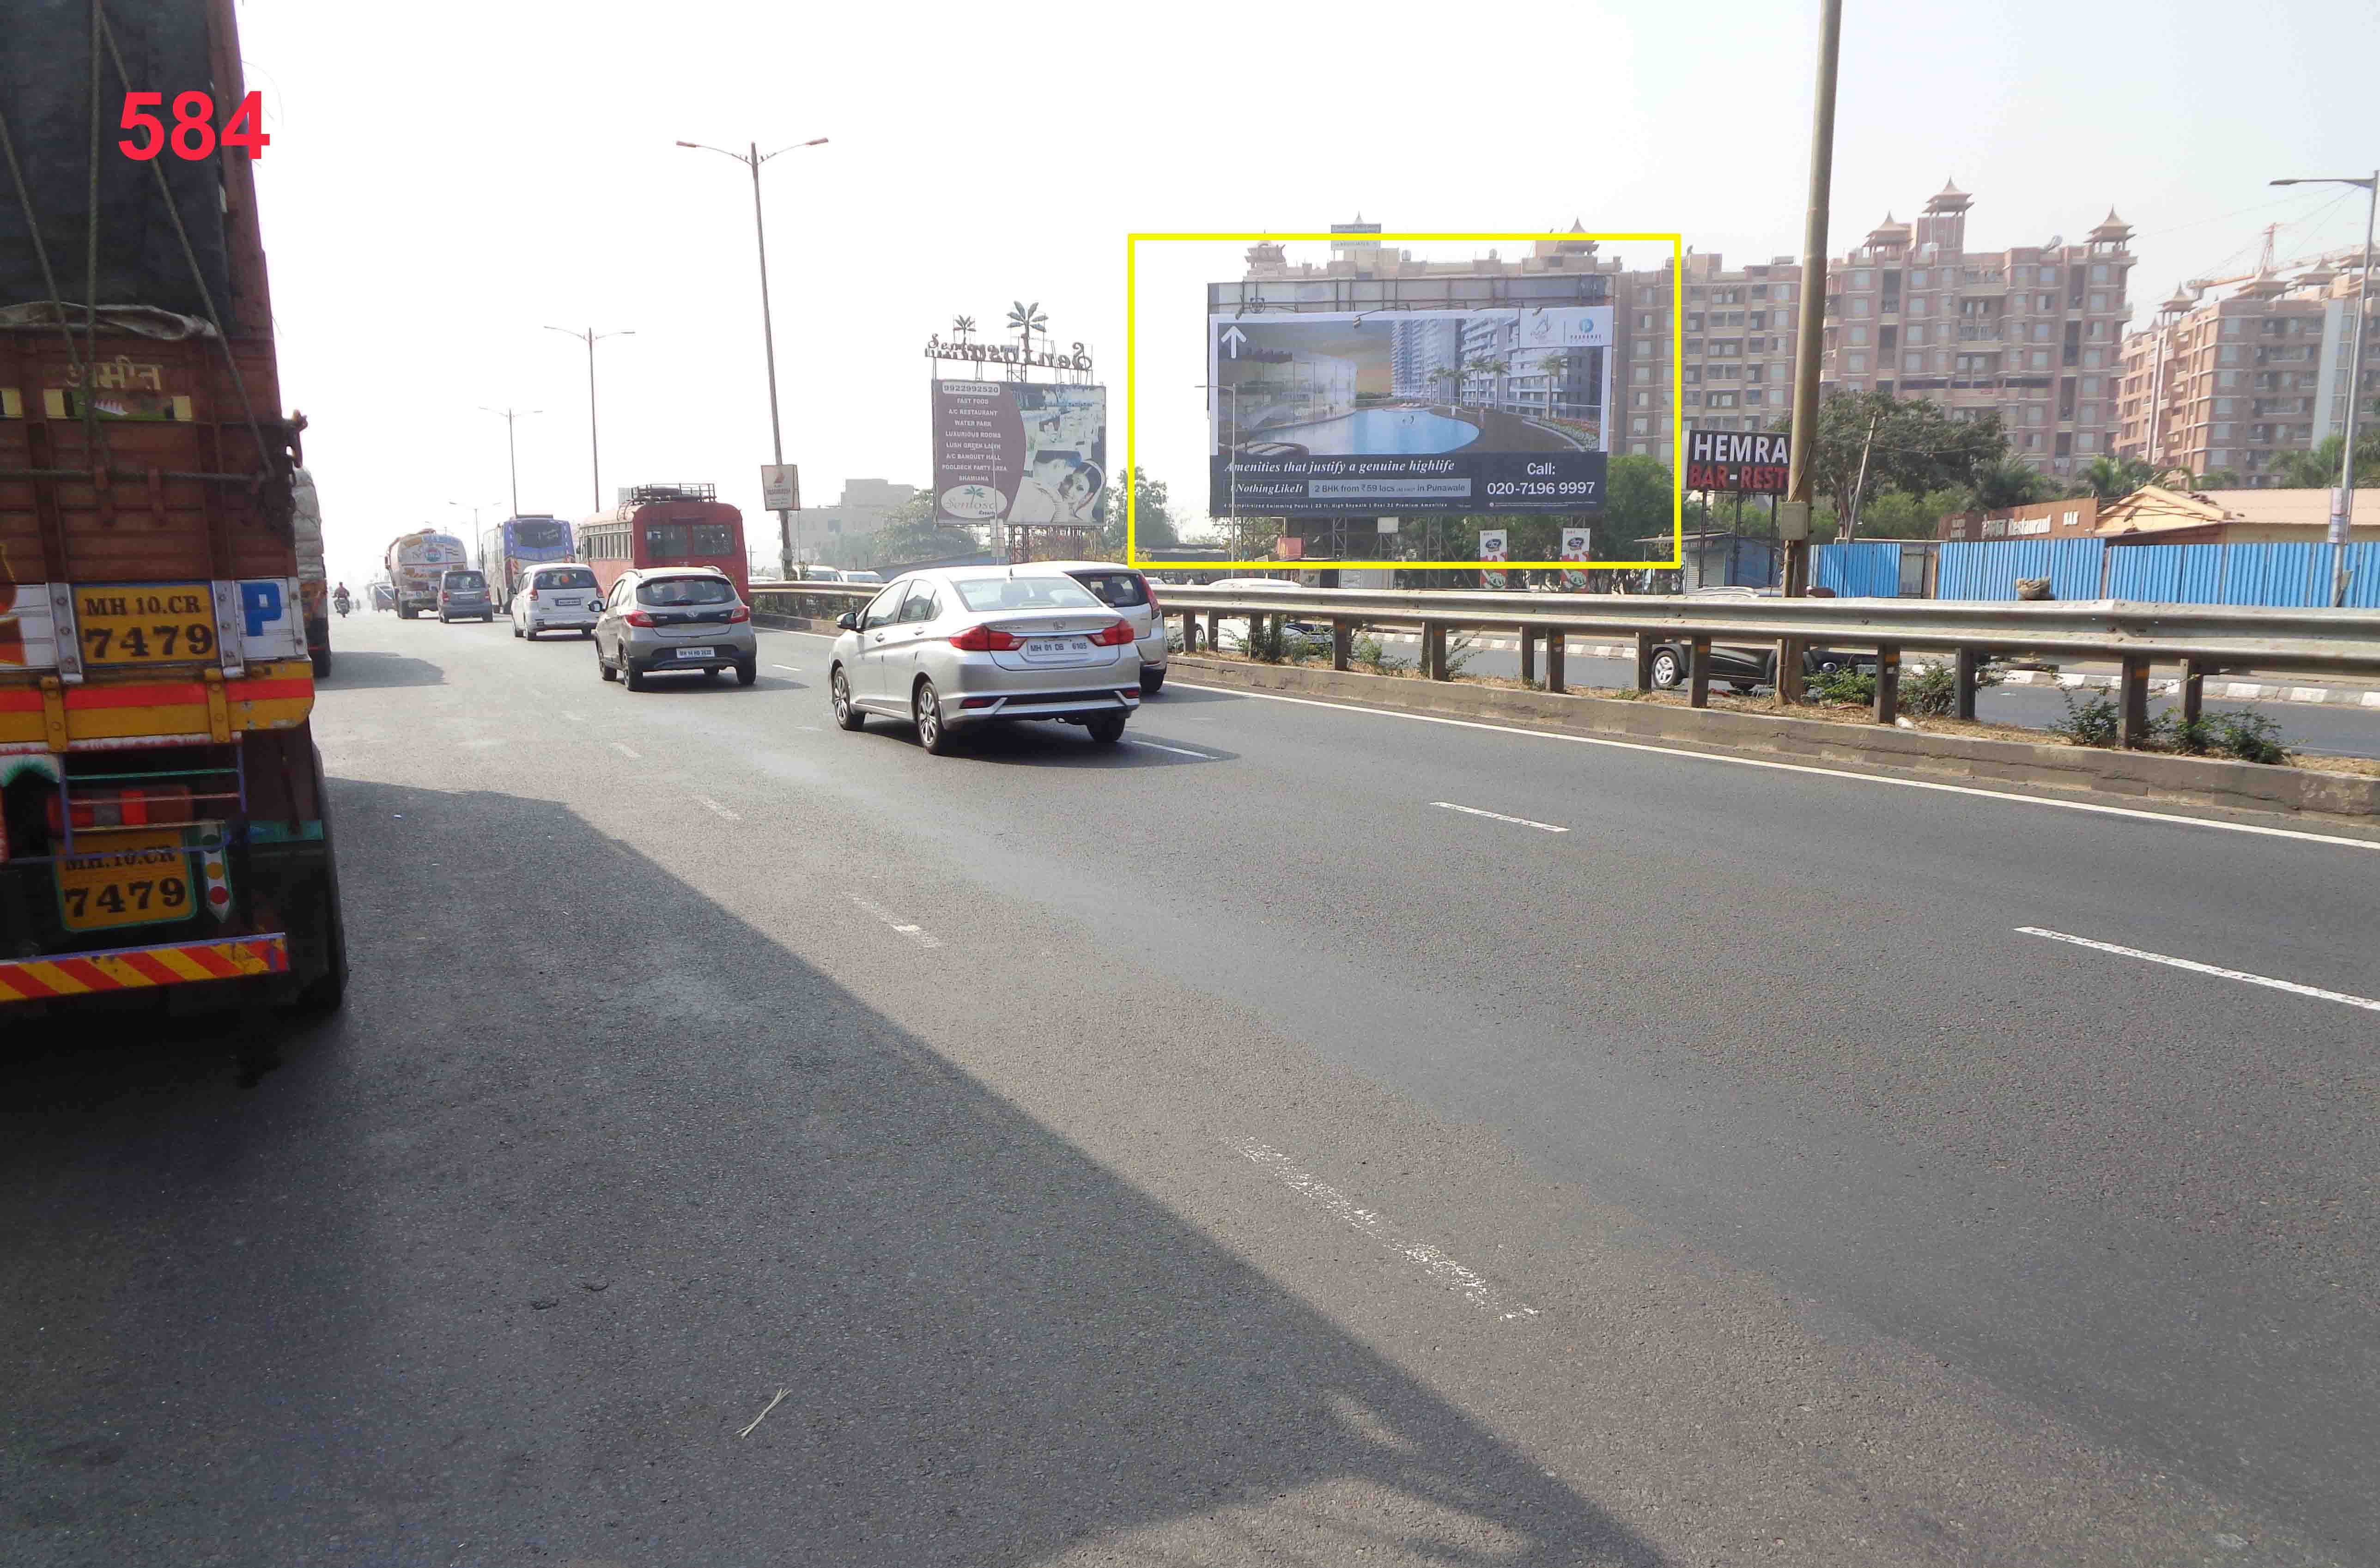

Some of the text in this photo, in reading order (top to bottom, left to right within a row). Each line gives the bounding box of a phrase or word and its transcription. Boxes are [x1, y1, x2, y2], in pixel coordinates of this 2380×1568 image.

[1694, 433, 1788, 464] HEMRA
[1224, 462, 1281, 473] Amenities
[1284, 462, 1306, 472] that
[1307, 461, 1345, 474] justify
[1359, 461, 1406, 474] genuine
[1409, 460, 1455, 473] highlife
[1527, 462, 1555, 475] Call:
[1688, 464, 1789, 489] BAR-REST
[1427, 484, 1465, 492] Punawale
[1487, 481, 1595, 495] 020-7196 9997
[2008, 514, 2051, 536] Restaurant
[85, 597, 128, 615] MH
[241, 582, 281, 637] P
[85, 624, 213, 658] 7479
[65, 877, 185, 917] 7479
